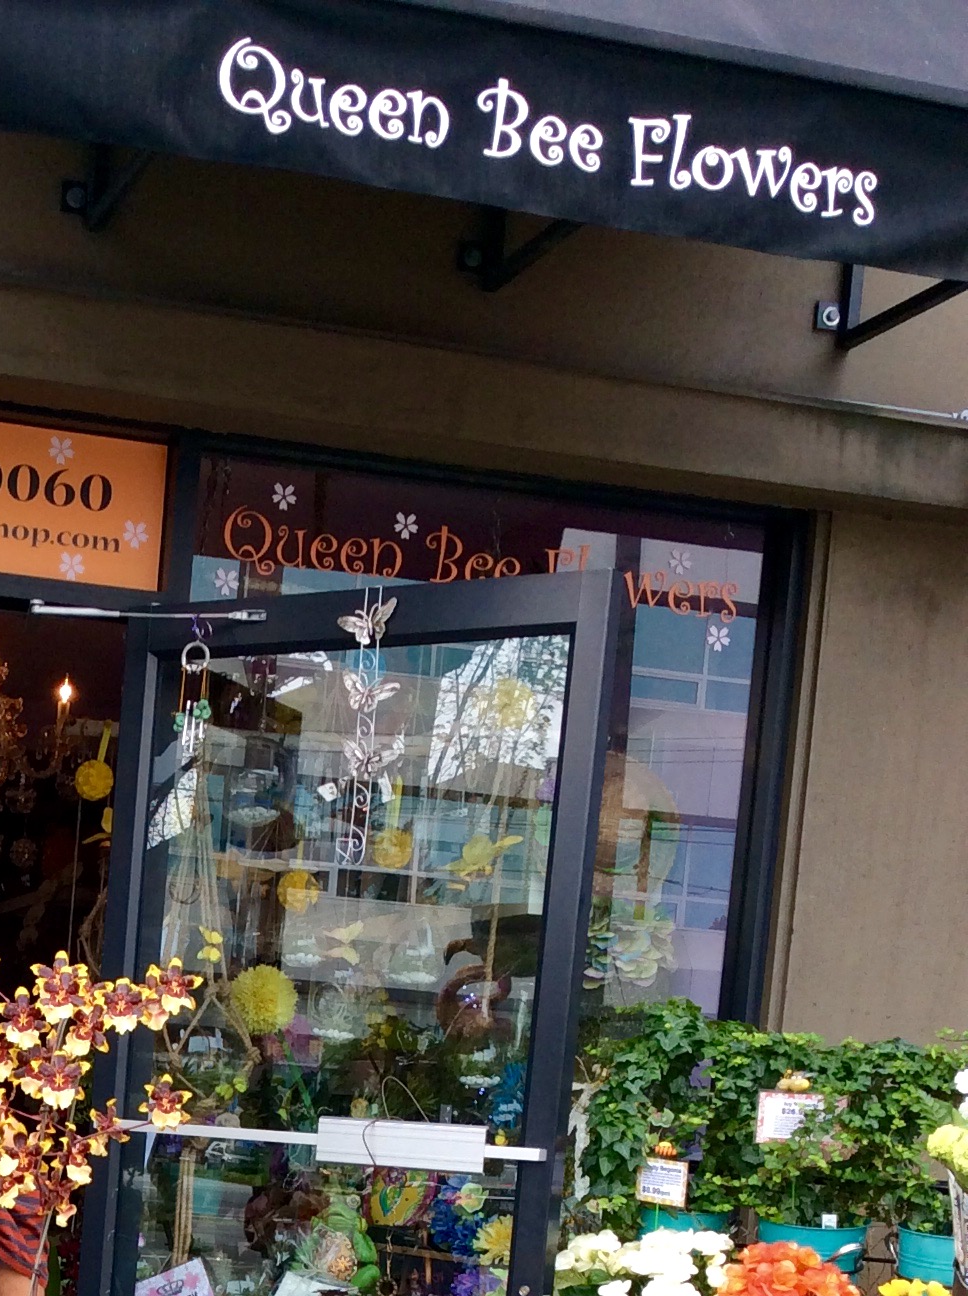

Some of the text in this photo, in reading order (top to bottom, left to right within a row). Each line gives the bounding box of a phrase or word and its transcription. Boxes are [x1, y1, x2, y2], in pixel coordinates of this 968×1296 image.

[218, 37, 878, 226] Queen Bee Flowers
[224, 504, 403, 579] Queen
[426, 525, 522, 583] Bee
